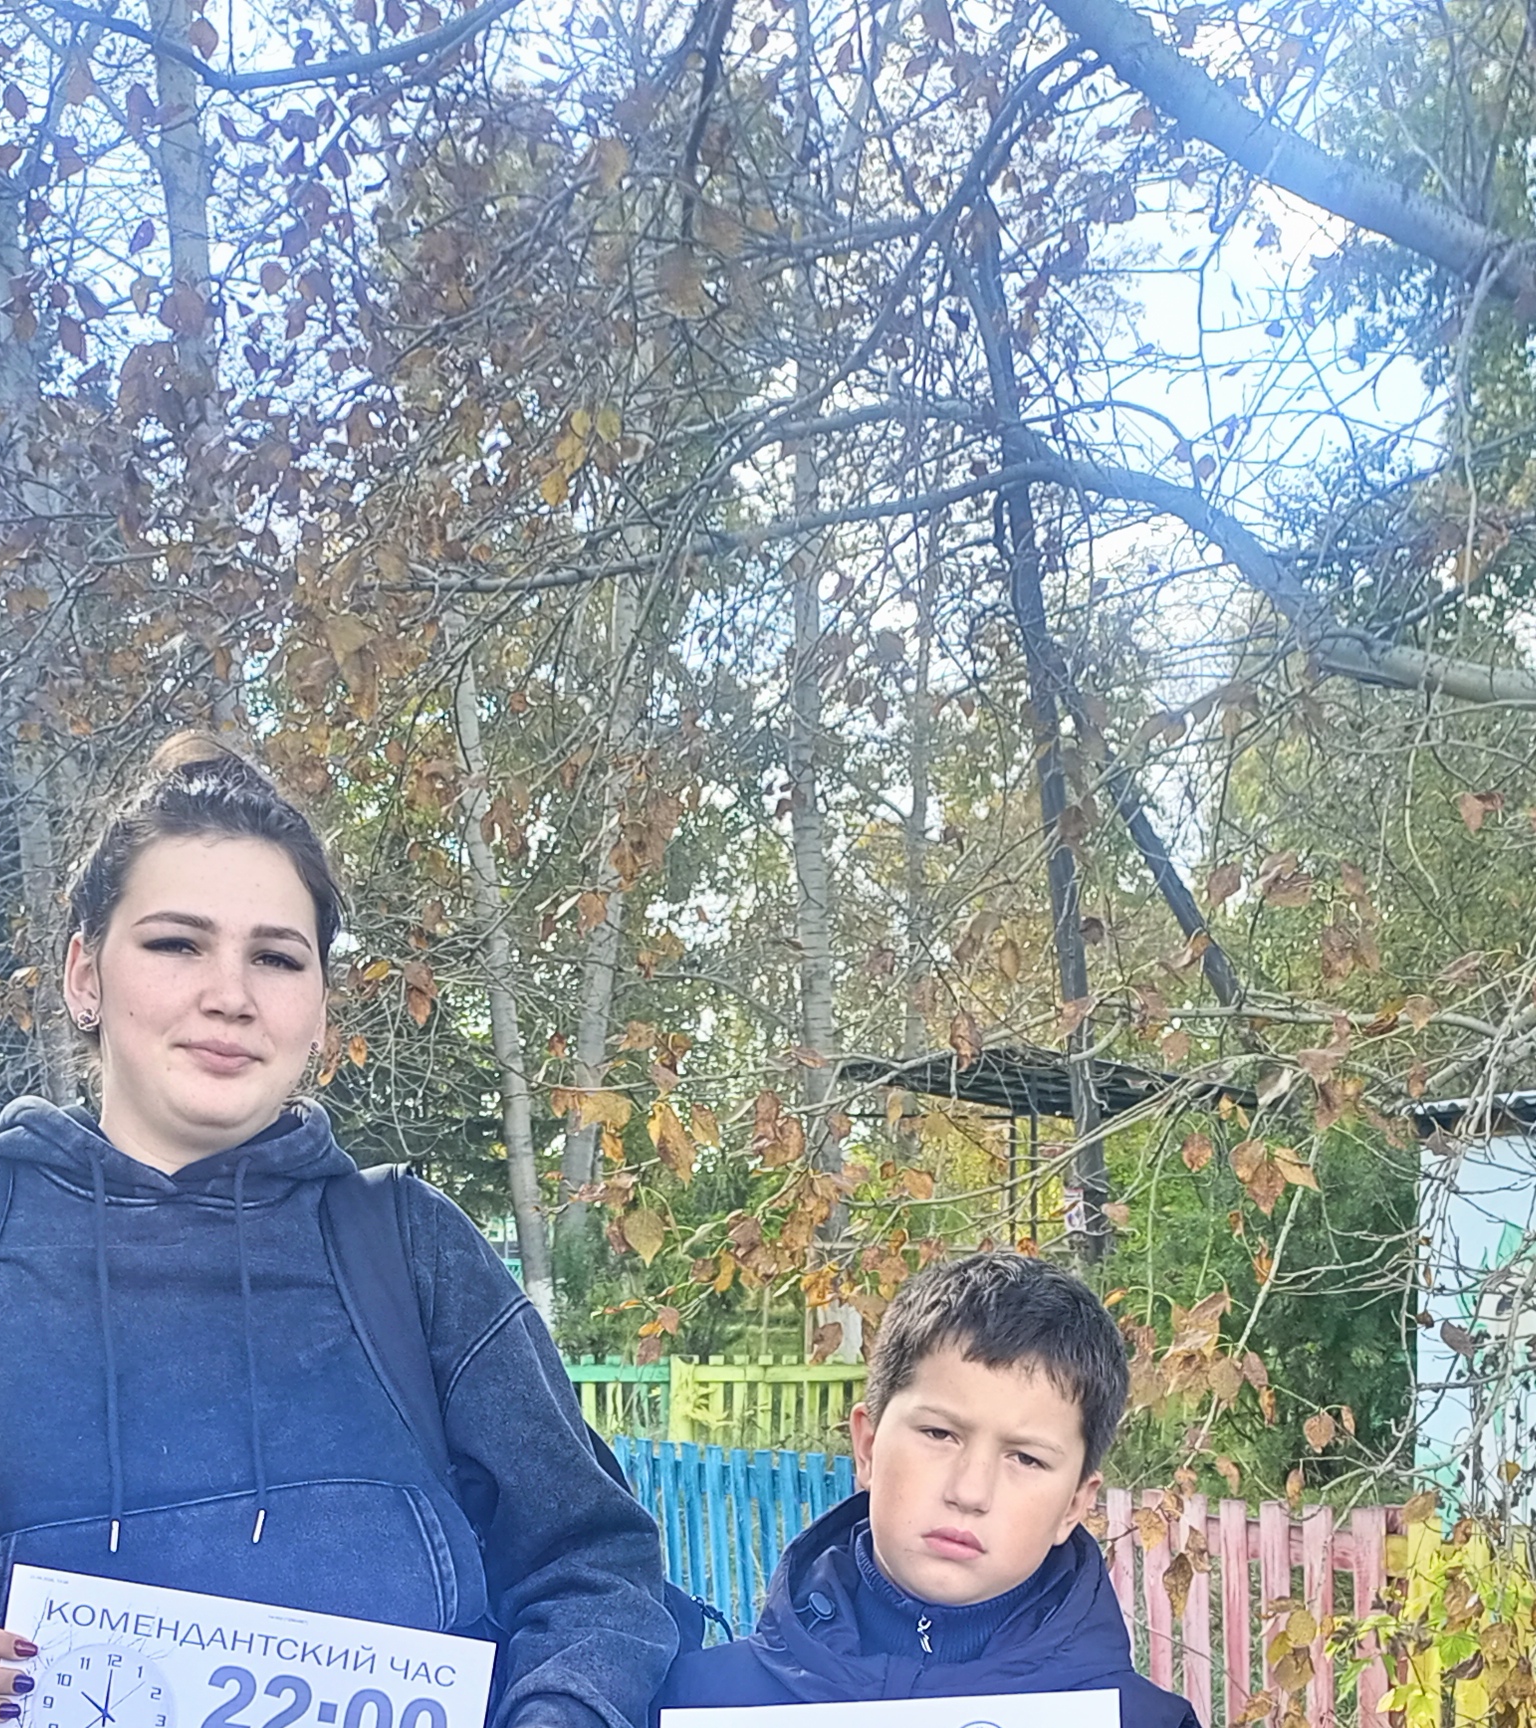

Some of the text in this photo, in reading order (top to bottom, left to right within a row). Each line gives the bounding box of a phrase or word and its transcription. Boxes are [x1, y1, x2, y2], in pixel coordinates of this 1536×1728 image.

[47, 1600, 457, 1687] КОМЕНДАНТСКИЙ ЧАС
[80, 1657, 91, 1670] 11
[107, 1654, 122, 1668] 12
[56, 1672, 72, 1687] 10
[137, 1666, 143, 1679] 1
[150, 1687, 162, 1701] 2
[43, 1695, 54, 1709] 9
[155, 1714, 166, 1727] 3
